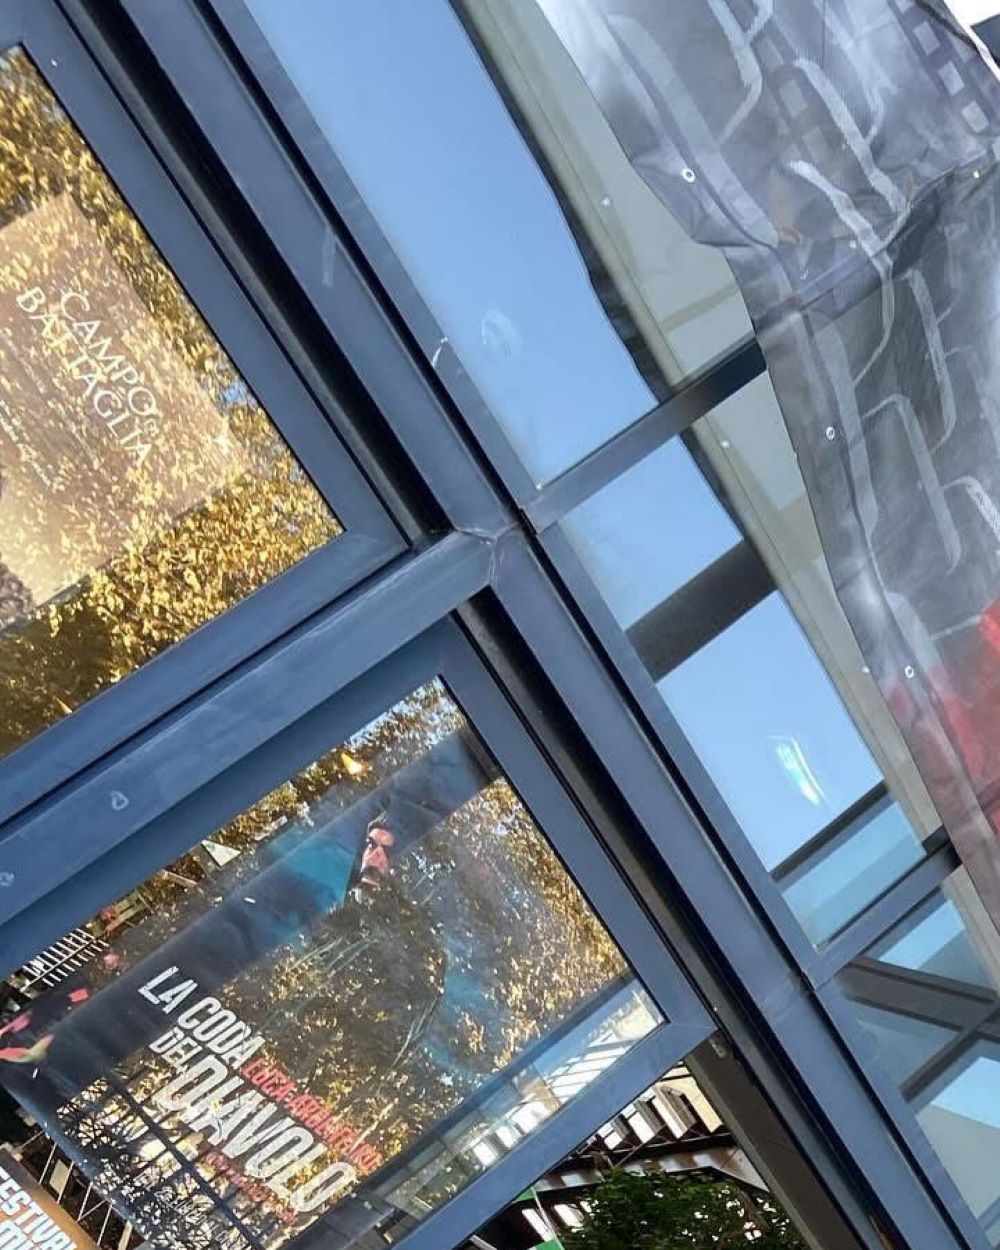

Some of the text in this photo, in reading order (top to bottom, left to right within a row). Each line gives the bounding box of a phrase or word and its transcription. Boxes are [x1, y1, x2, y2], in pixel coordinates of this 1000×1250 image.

[16, 286, 152, 464] BATTAGLIA
[60, 291, 157, 417] CAMPO
[138, 966, 266, 1069] LA CODA
[149, 1025, 203, 1073] DEL
[153, 1054, 358, 1212] DIAVOLO
